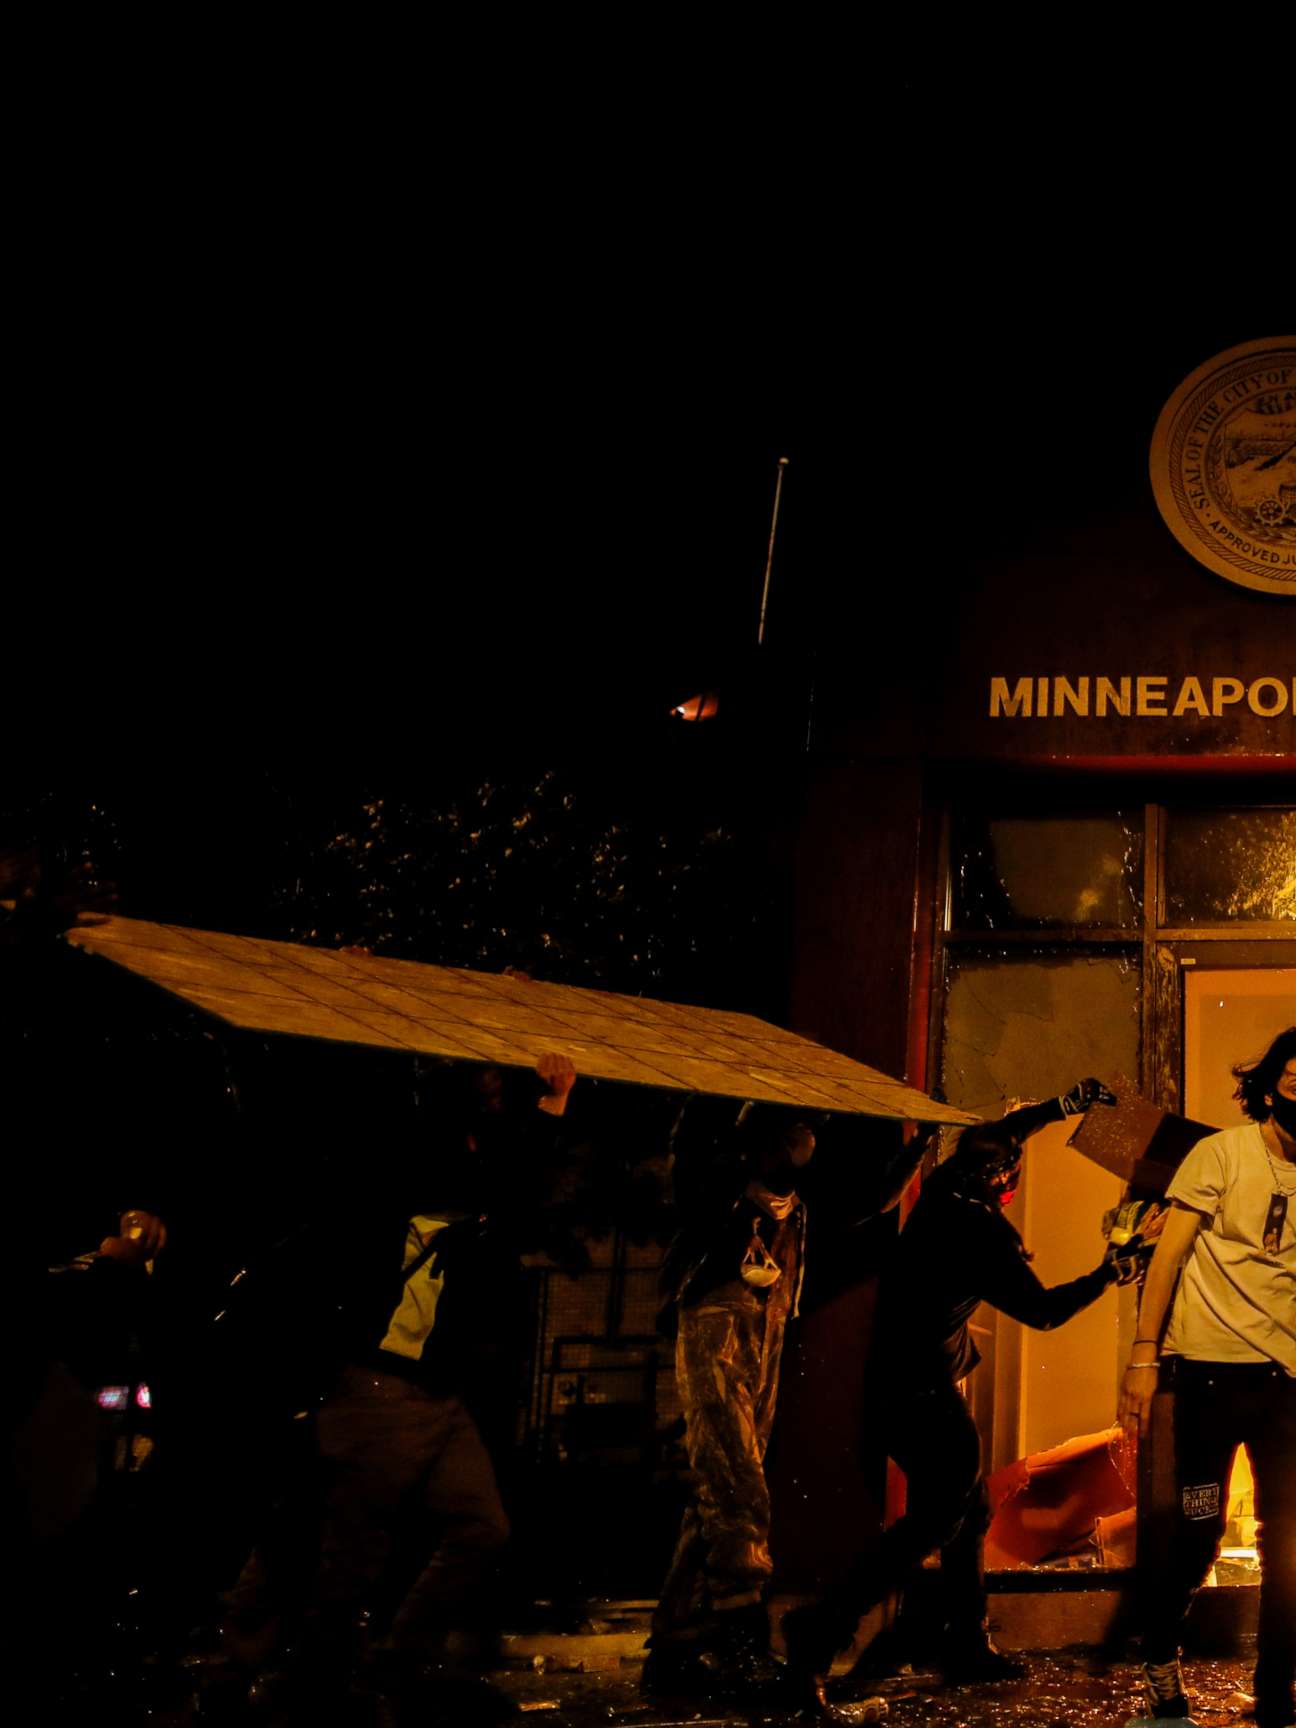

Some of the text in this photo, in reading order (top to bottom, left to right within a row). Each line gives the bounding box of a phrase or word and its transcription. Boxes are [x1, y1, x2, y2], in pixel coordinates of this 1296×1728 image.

[1222, 374, 1263, 405] CITY
[1266, 370, 1294, 386] OF
[1193, 400, 1221, 434] THE
[1185, 436, 1203, 461] OF
[1184, 463, 1209, 510] SEAL
[1209, 520, 1280, 564] APPROVED
